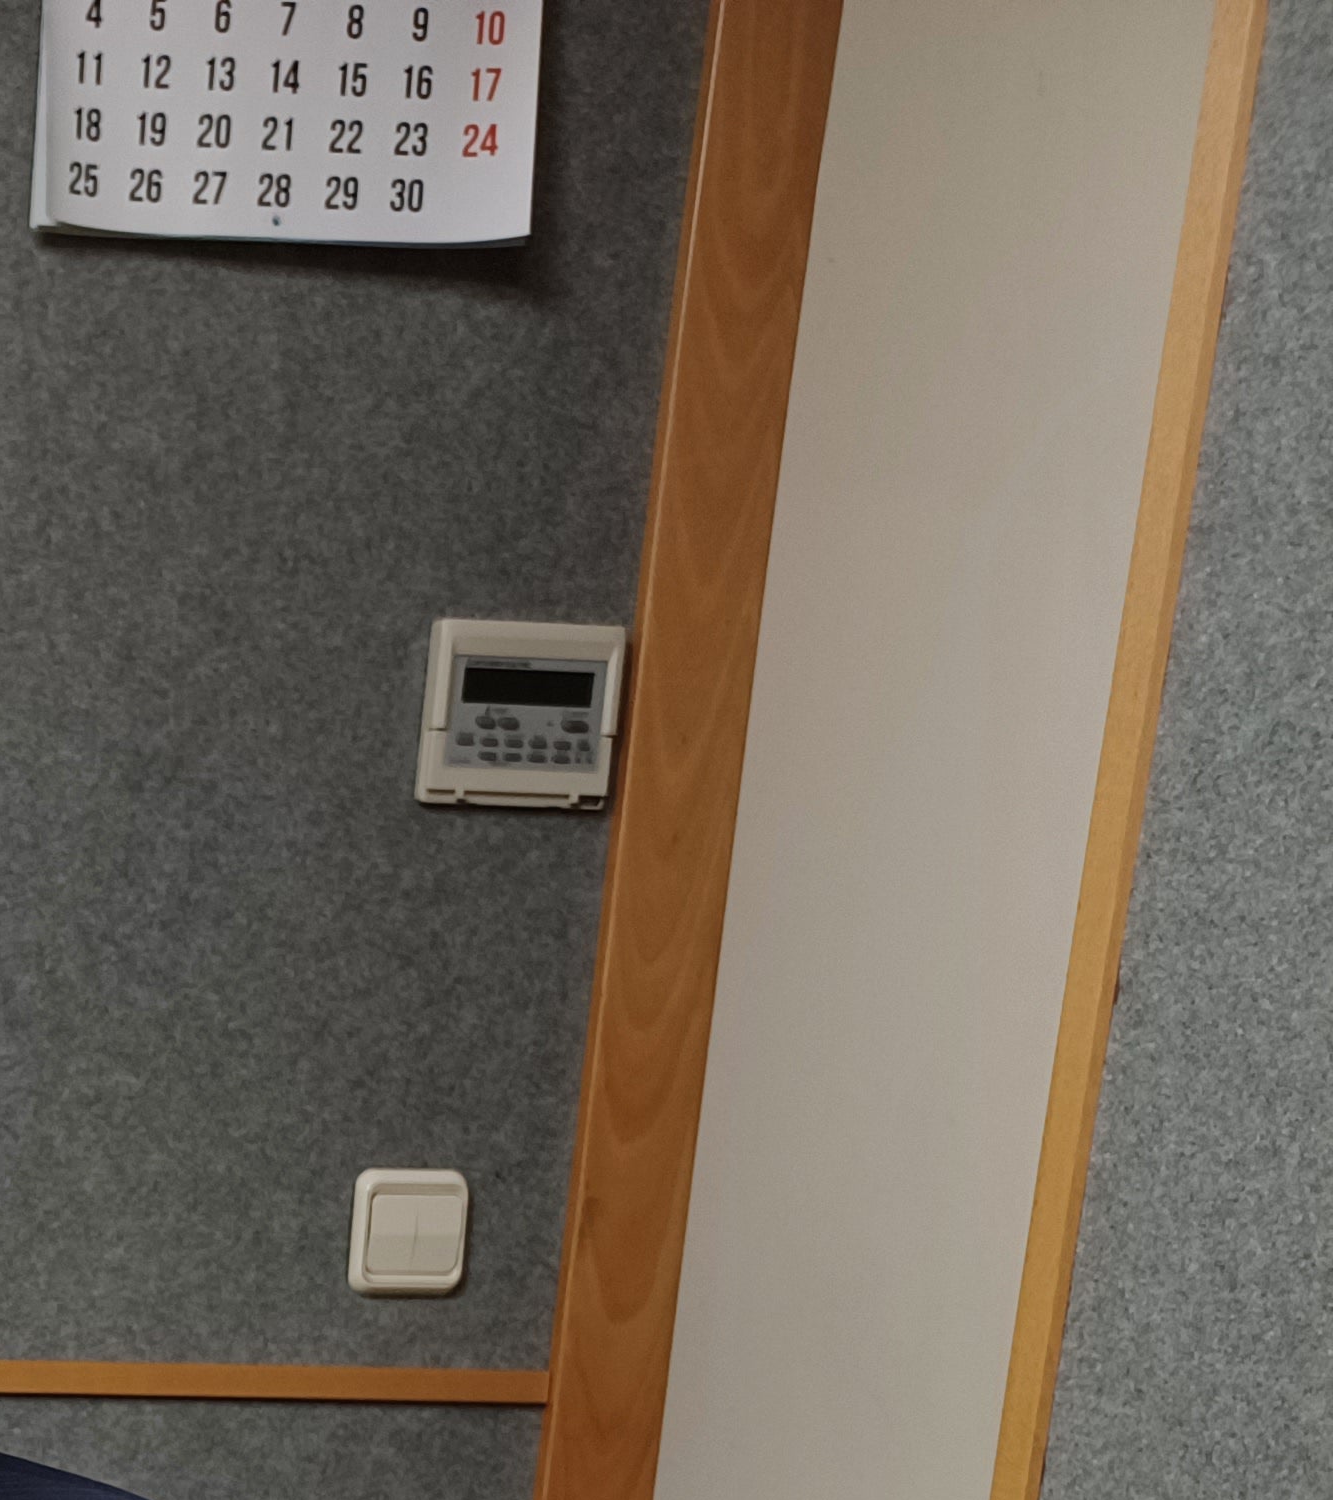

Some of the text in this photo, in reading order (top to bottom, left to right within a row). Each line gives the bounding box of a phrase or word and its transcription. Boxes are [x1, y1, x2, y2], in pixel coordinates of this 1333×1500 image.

[85, 0, 506, 46] 4 5 6 7 8 9 10
[76, 50, 503, 102] 11 12 13 14 15 16 17
[74, 106, 499, 158] 18 19 20 21 22 23 24
[68, 160, 425, 213] 25 26 27 28 29 30
